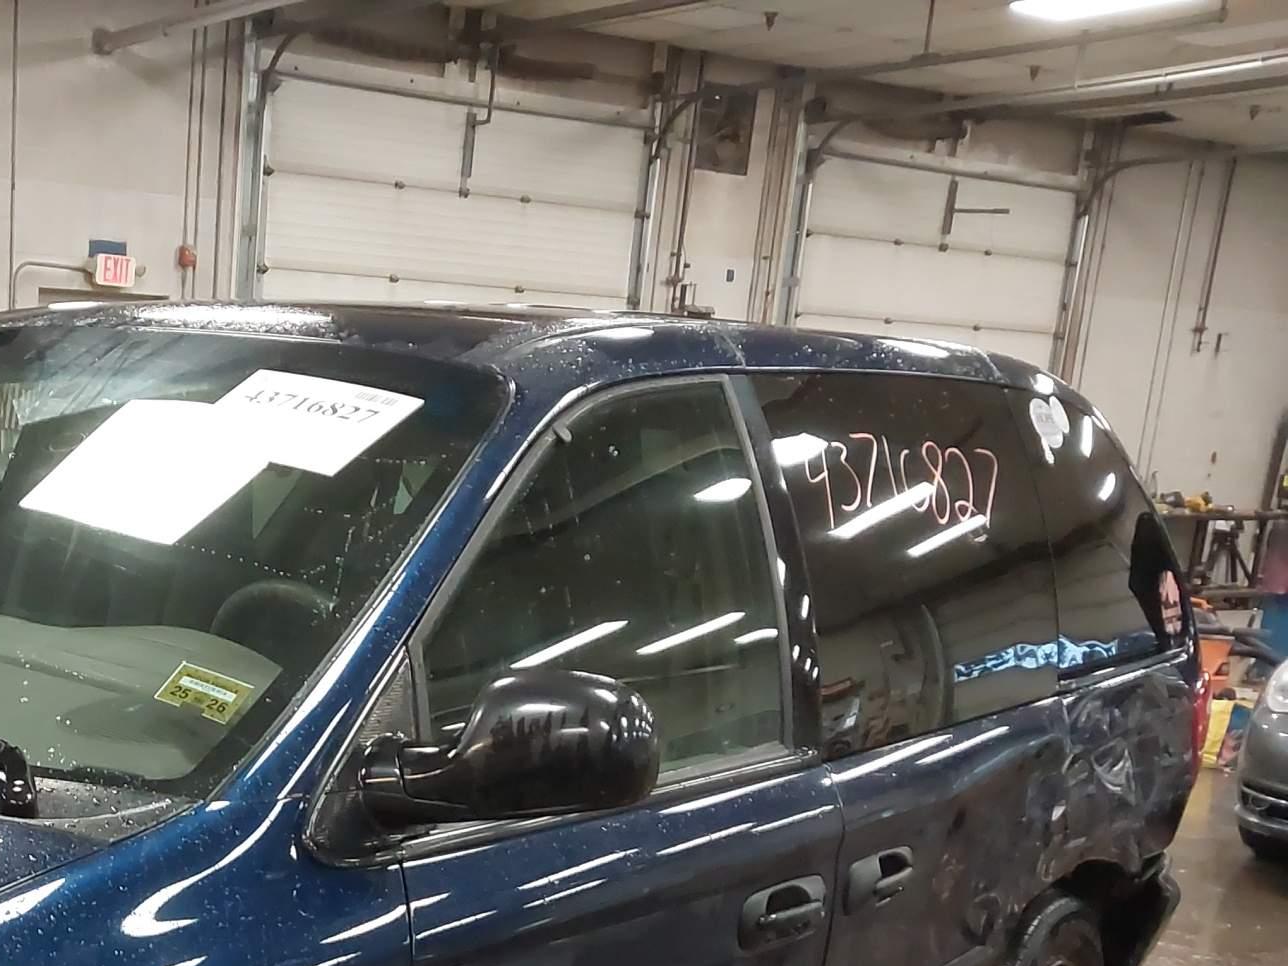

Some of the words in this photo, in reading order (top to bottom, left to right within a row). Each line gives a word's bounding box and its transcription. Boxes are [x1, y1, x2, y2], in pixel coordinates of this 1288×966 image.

[103, 255, 131, 284] EXIT
[244, 390, 380, 423] 43716827
[170, 685, 192, 699] 25
[206, 698, 228, 713] 26
